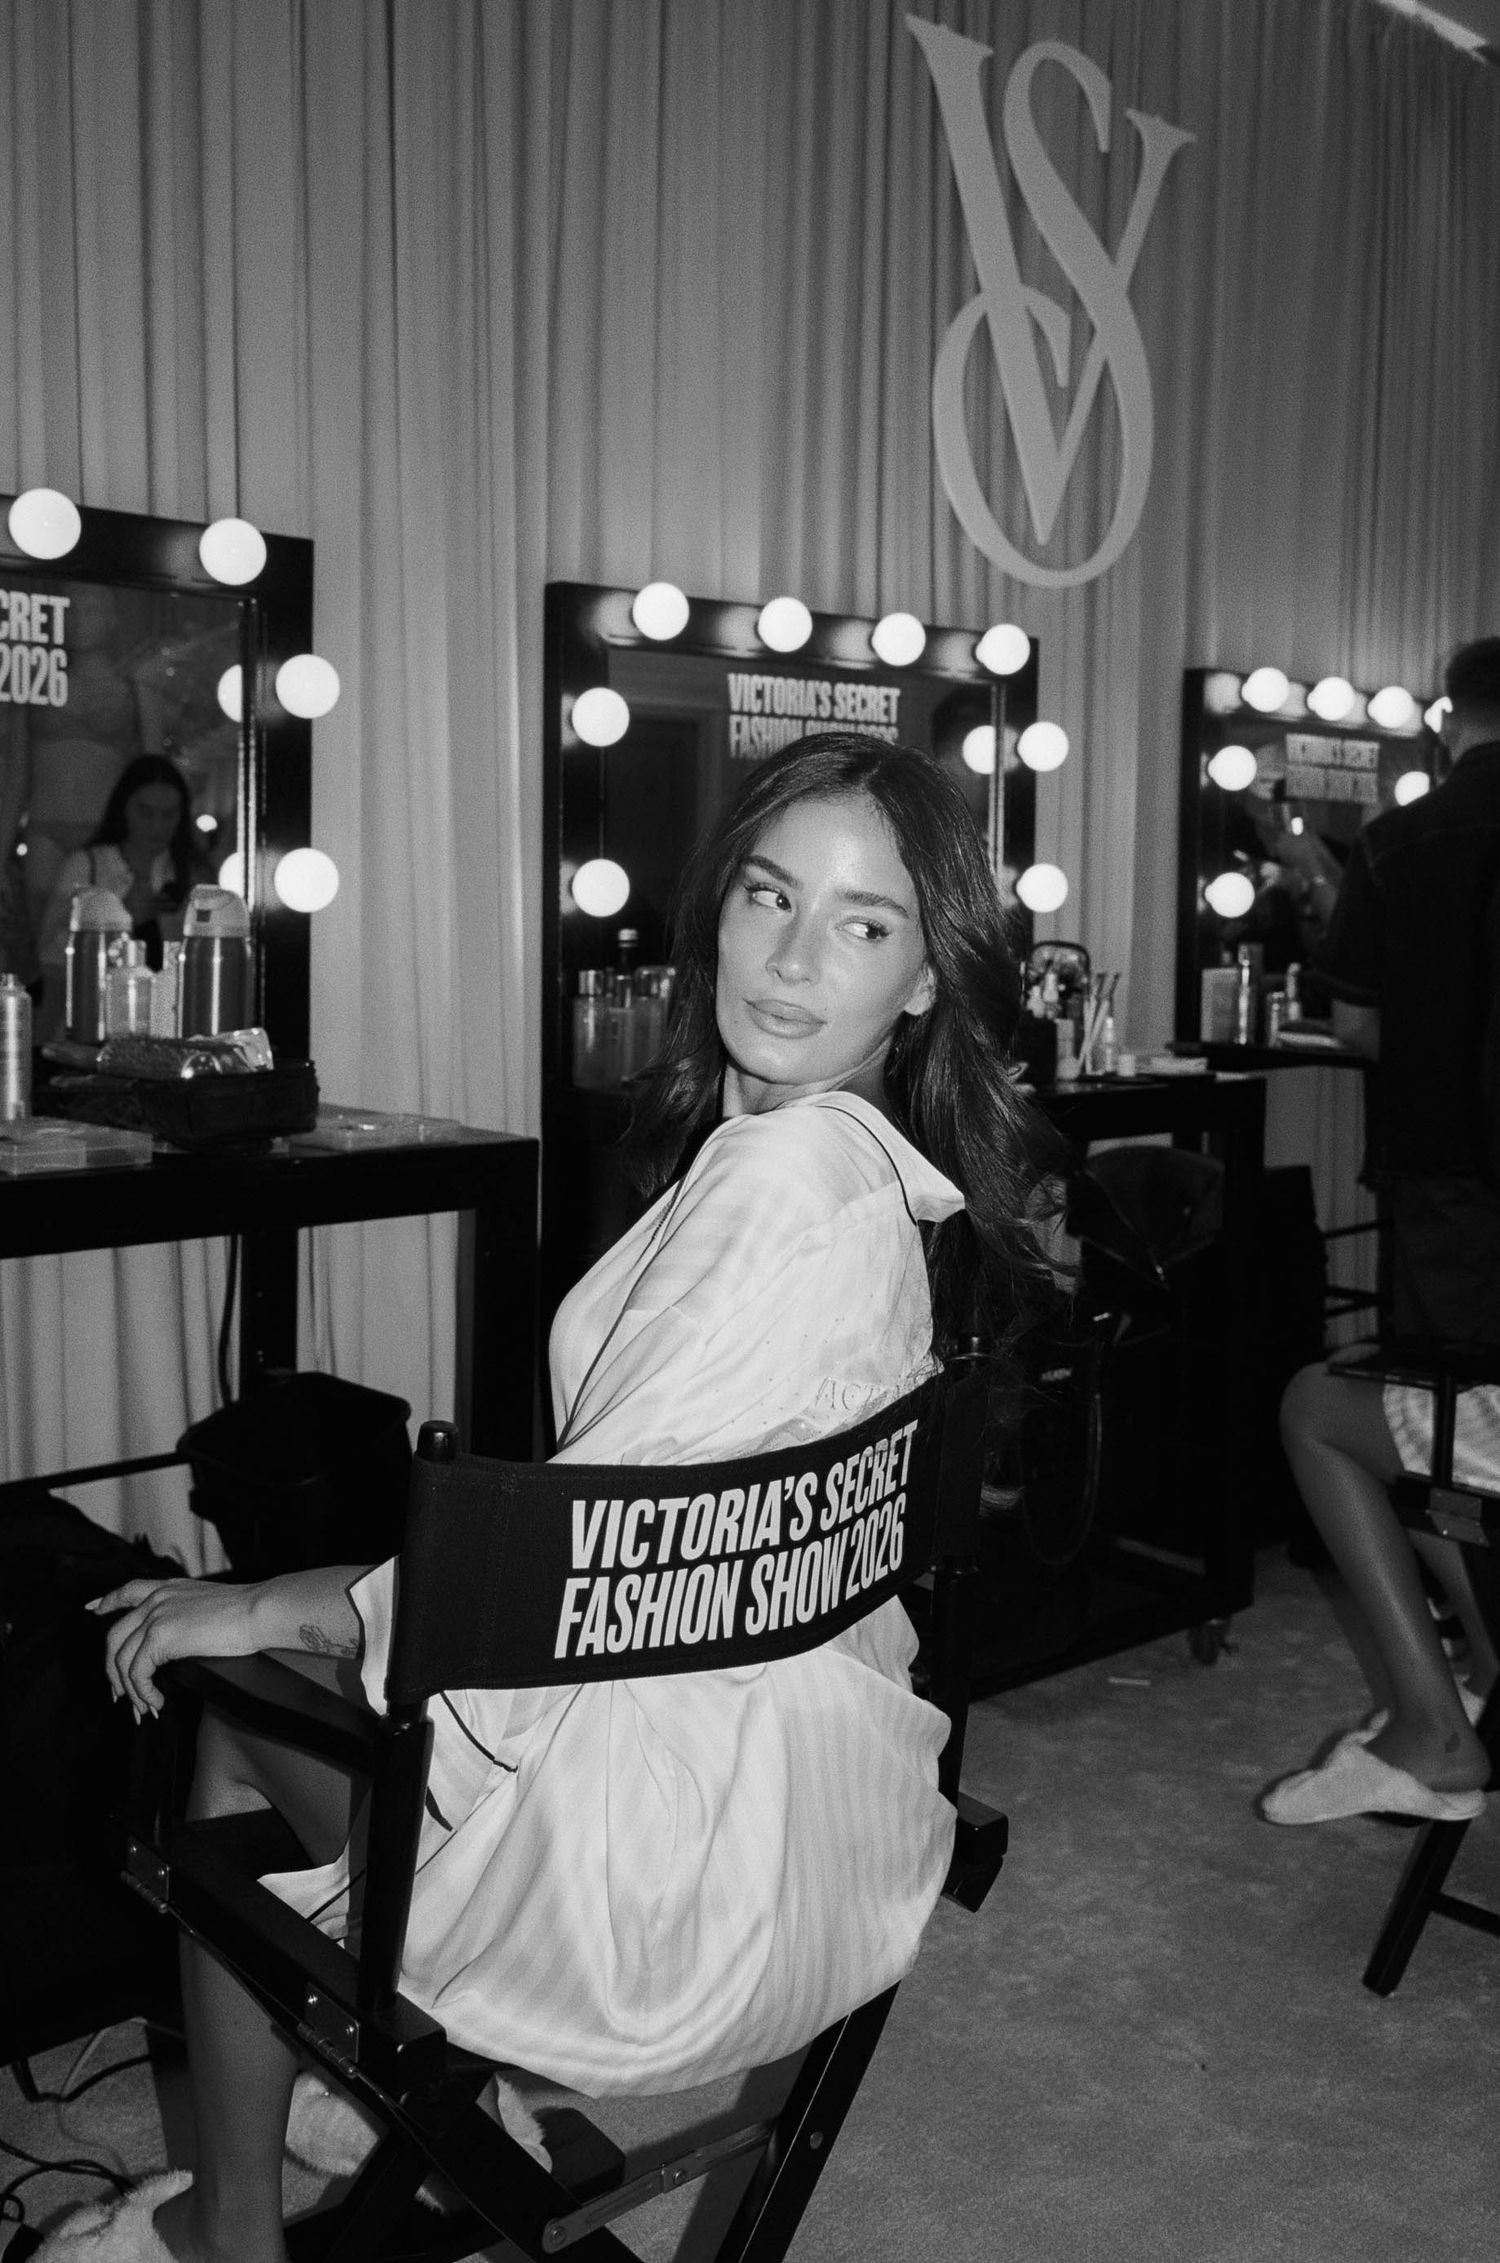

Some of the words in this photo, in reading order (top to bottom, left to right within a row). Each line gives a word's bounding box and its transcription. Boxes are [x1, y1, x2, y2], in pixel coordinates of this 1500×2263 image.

[0, 642, 68, 707] 2026
[727, 672, 832, 718] VICTORIA'S
[833, 682, 901, 724] SECRET
[572, 1472, 817, 1569] VICTORIA'S
[820, 1420, 918, 1531] SECRET
[555, 1560, 743, 1658] FASHION
[745, 1527, 849, 1635] SHOW
[846, 1493, 906, 1600] 2026
